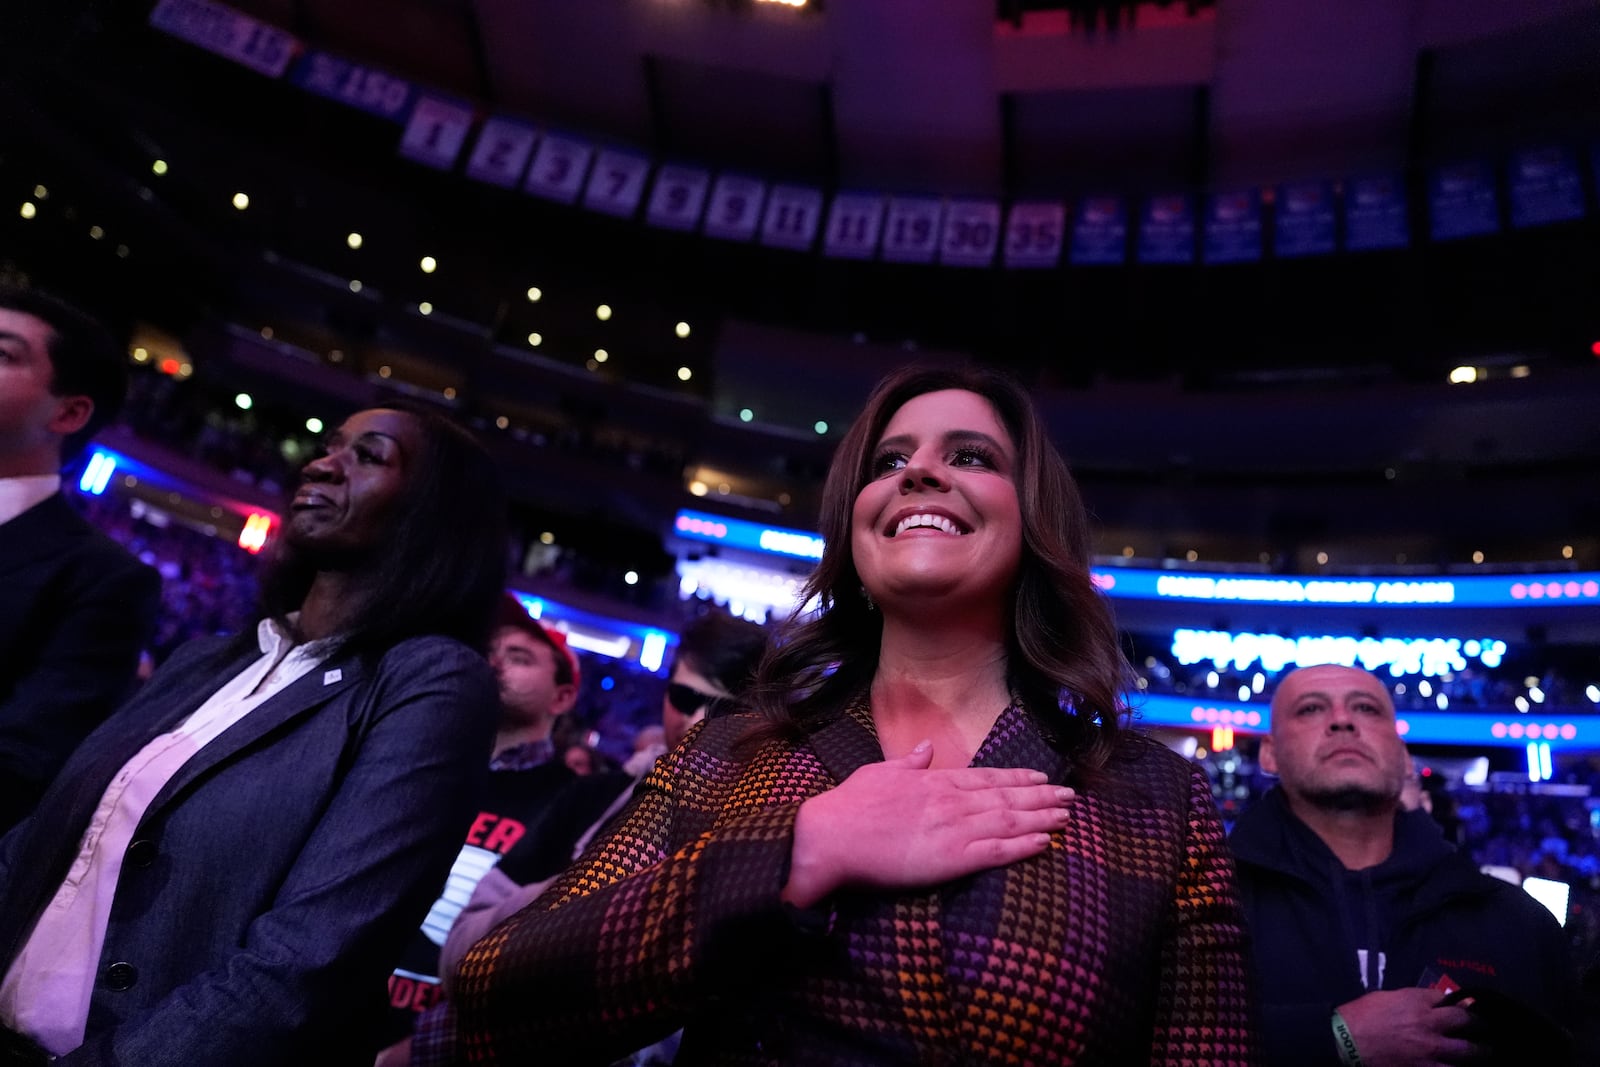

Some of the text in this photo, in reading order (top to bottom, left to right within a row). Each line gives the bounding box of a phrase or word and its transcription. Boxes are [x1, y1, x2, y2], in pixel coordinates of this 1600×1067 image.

[424, 123, 444, 149] 1
[487, 140, 514, 168] 2
[608, 171, 628, 197] 7
[776, 205, 806, 233] 11
[838, 215, 867, 243] 11
[893, 217, 932, 245] 19
[949, 221, 991, 250] 30
[1012, 222, 1056, 250] 35
[1336, 1024, 1360, 1061] FLOOR
